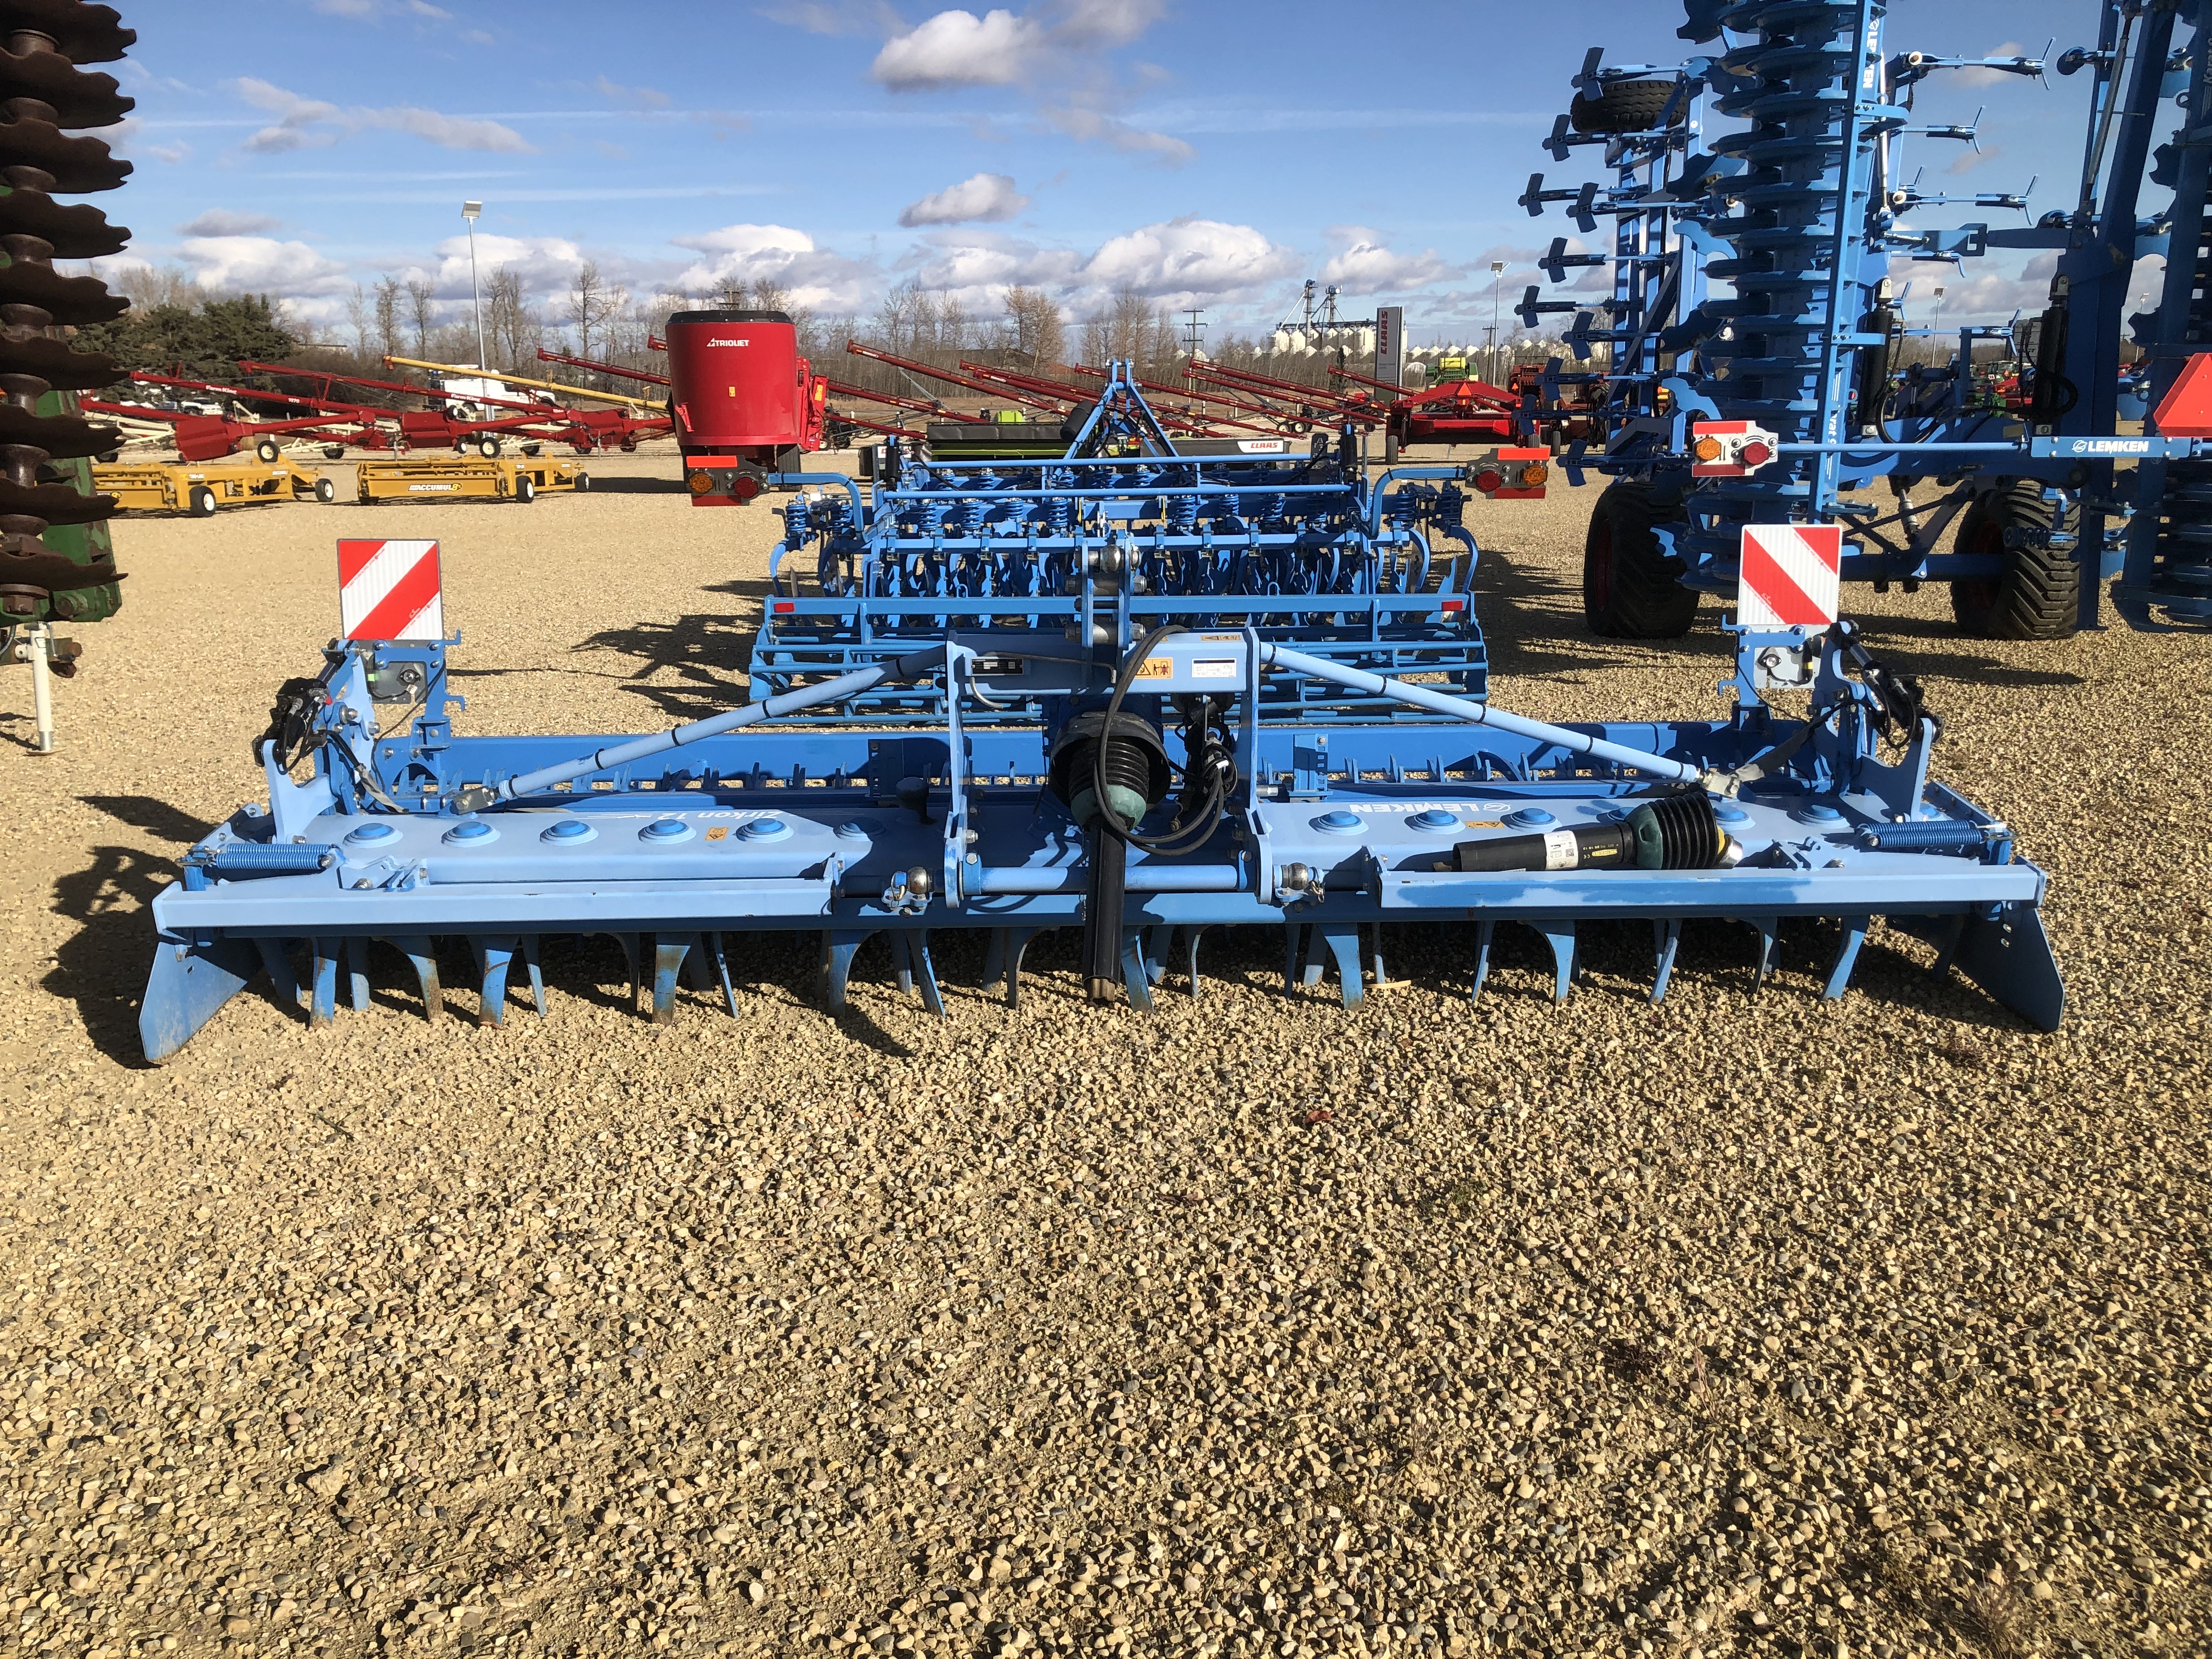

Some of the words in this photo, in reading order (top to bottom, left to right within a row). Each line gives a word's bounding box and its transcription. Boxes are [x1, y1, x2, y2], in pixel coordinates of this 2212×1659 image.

[1863, 31, 1878, 88] LEEN
[1380, 311, 1389, 355] CLAAS
[2087, 441, 2149, 453] LEMKEN
[1350, 803, 1480, 812] LEMKEN
[697, 810, 782, 820] Zirkon
